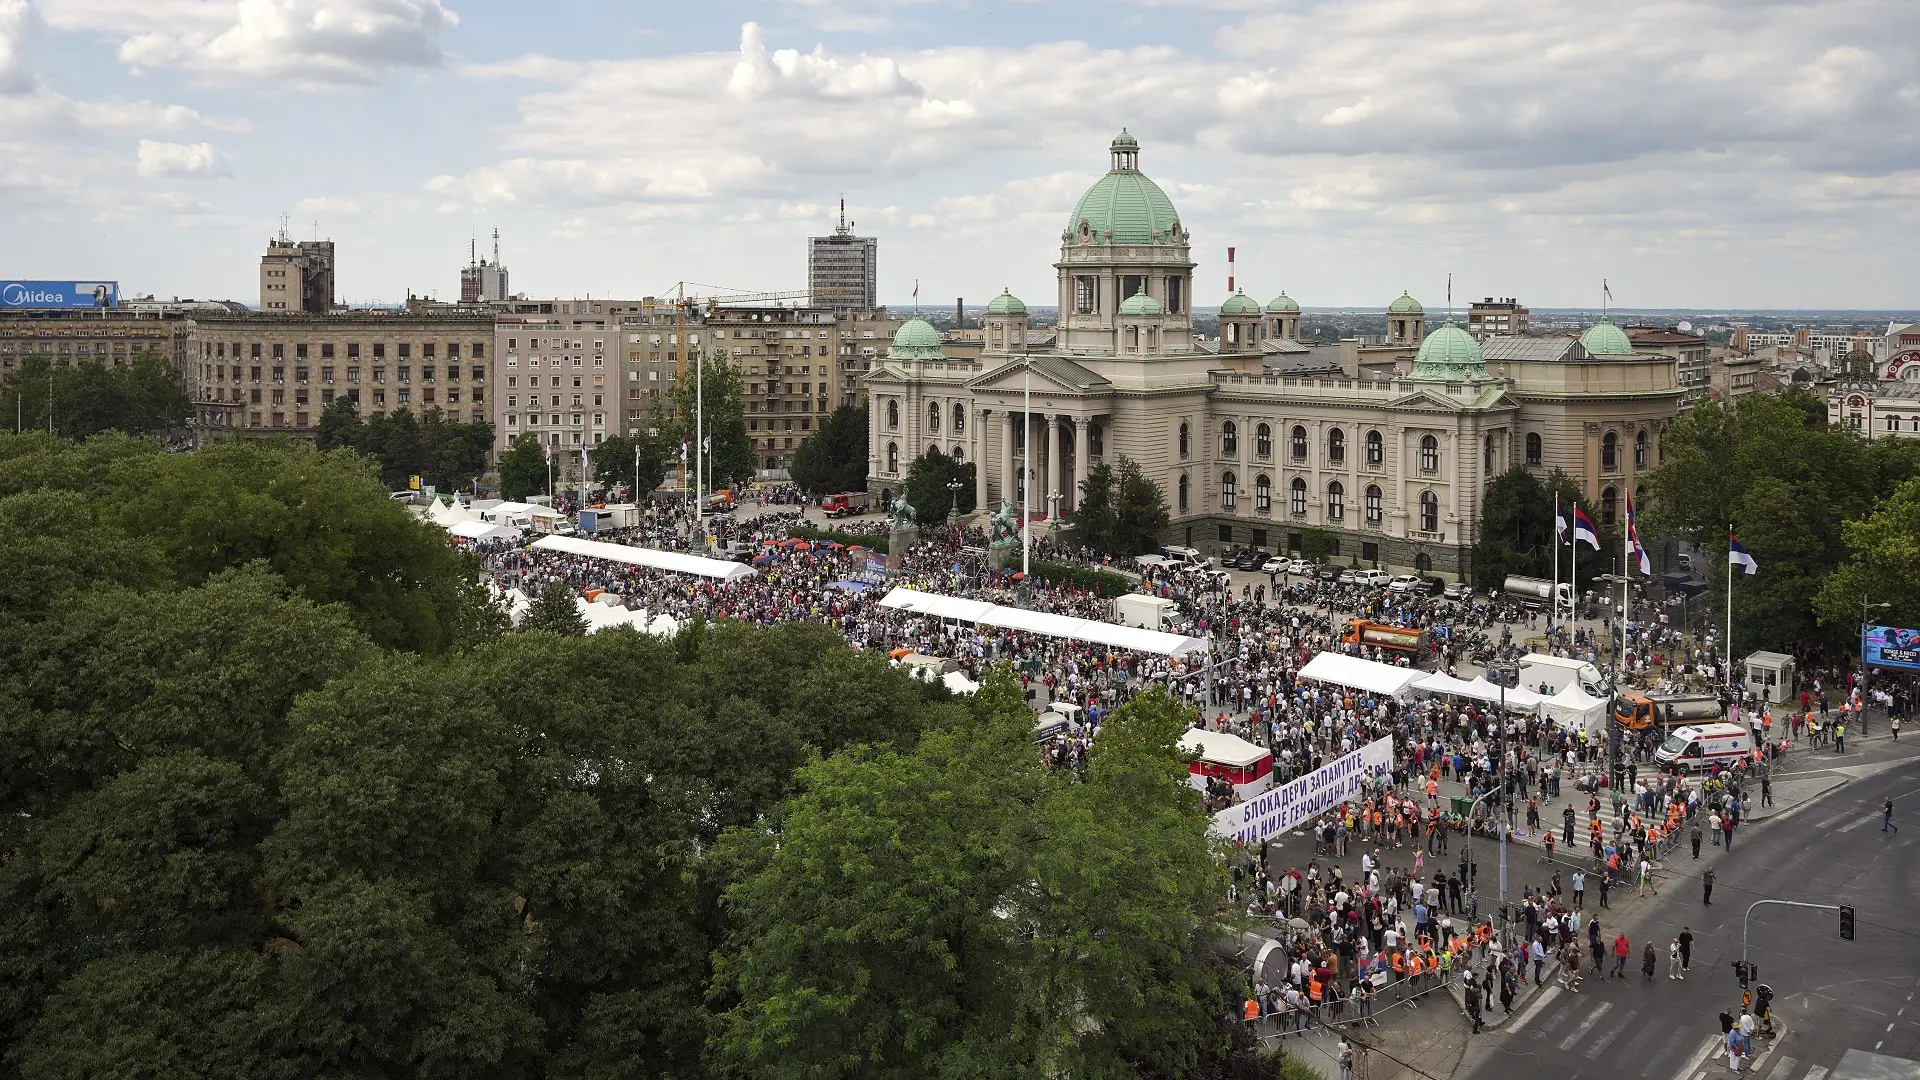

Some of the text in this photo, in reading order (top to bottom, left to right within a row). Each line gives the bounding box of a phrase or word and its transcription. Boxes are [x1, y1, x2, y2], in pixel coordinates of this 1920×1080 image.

[13, 290, 63, 303] Midea
[1244, 752, 1366, 823] БЛОКАДЕРИ ЗАПАМТИТЕ,
[1260, 810, 1287, 837] НИЈЕ
[1290, 781, 1345, 823] ГЕНОЦИДНА
[1348, 760, 1389, 796] ДРВА!
